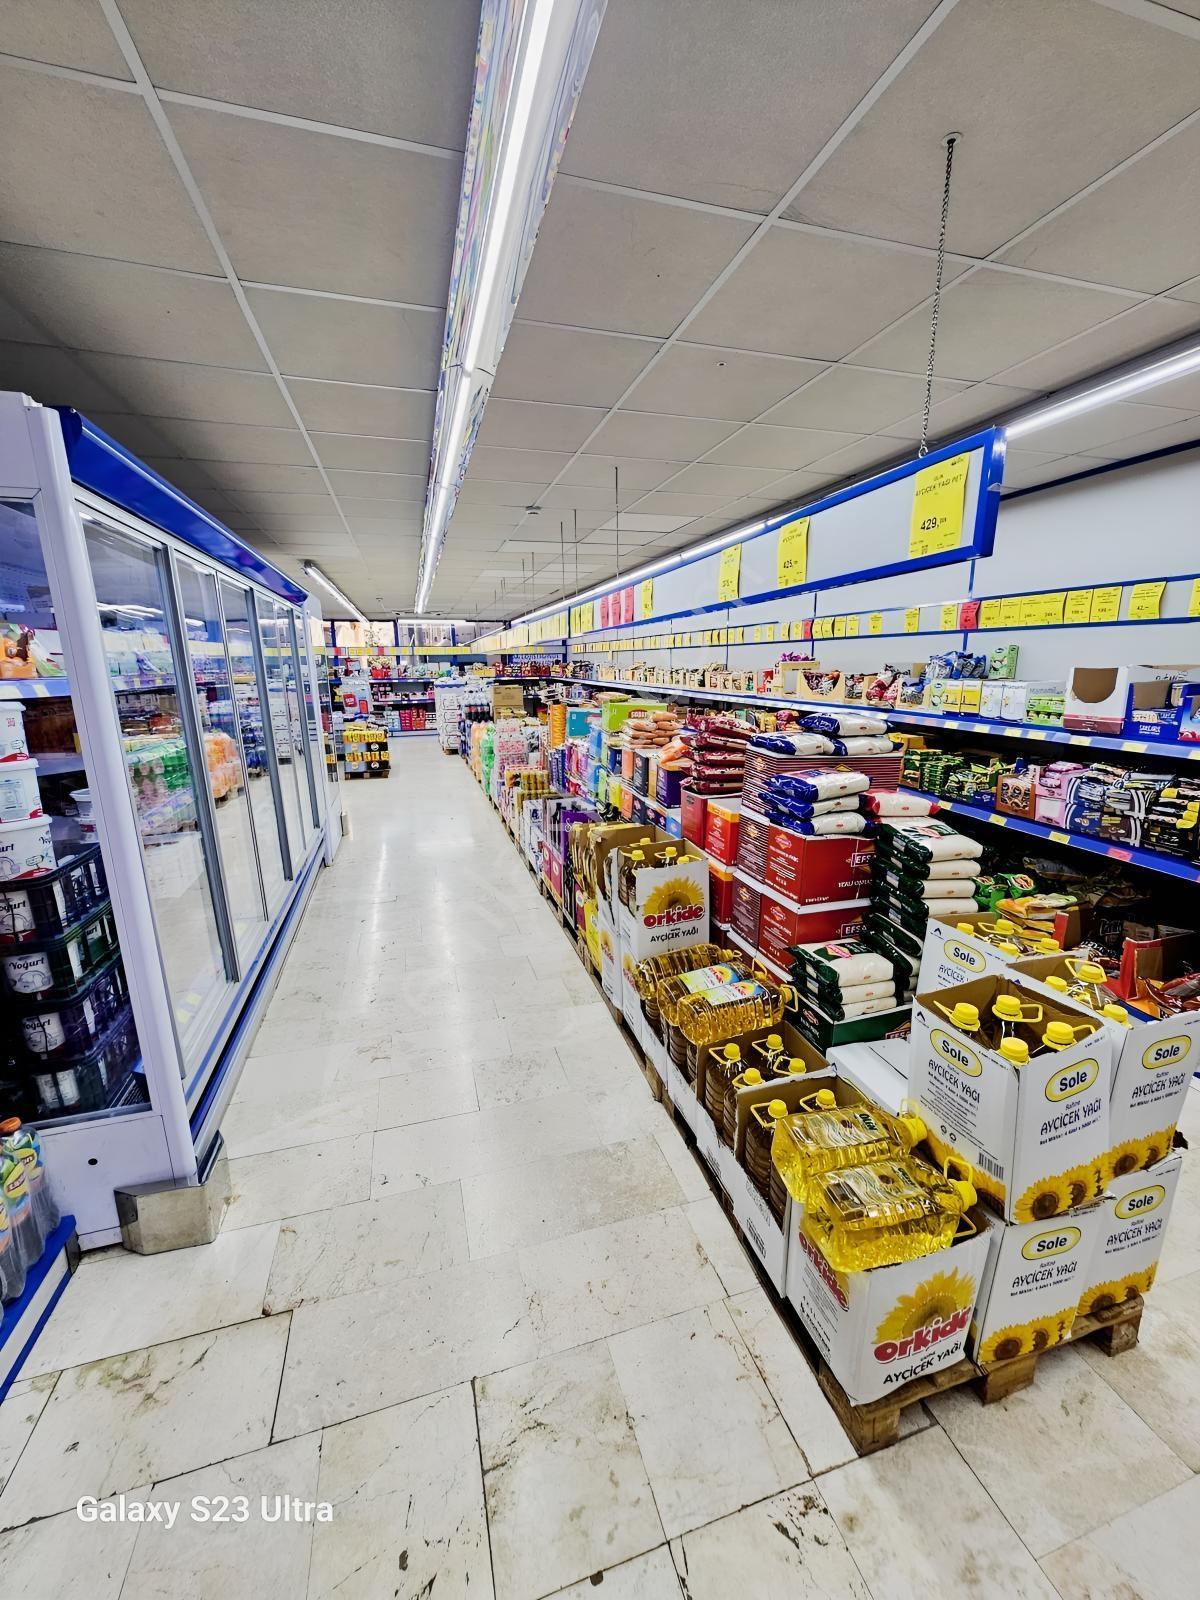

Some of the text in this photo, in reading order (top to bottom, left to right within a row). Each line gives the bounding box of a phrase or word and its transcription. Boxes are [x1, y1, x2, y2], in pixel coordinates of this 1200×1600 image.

[643, 905, 705, 929] orkide
[953, 947, 976, 966] Sole
[942, 1040, 969, 1067] Sole
[1154, 1045, 1180, 1061] Sole
[1059, 1071, 1088, 1092] Sole
[1127, 1195, 1154, 1212] Sole
[1036, 1236, 1067, 1253] Sole
[883, 1357, 935, 1385] AYÇİÇEK
